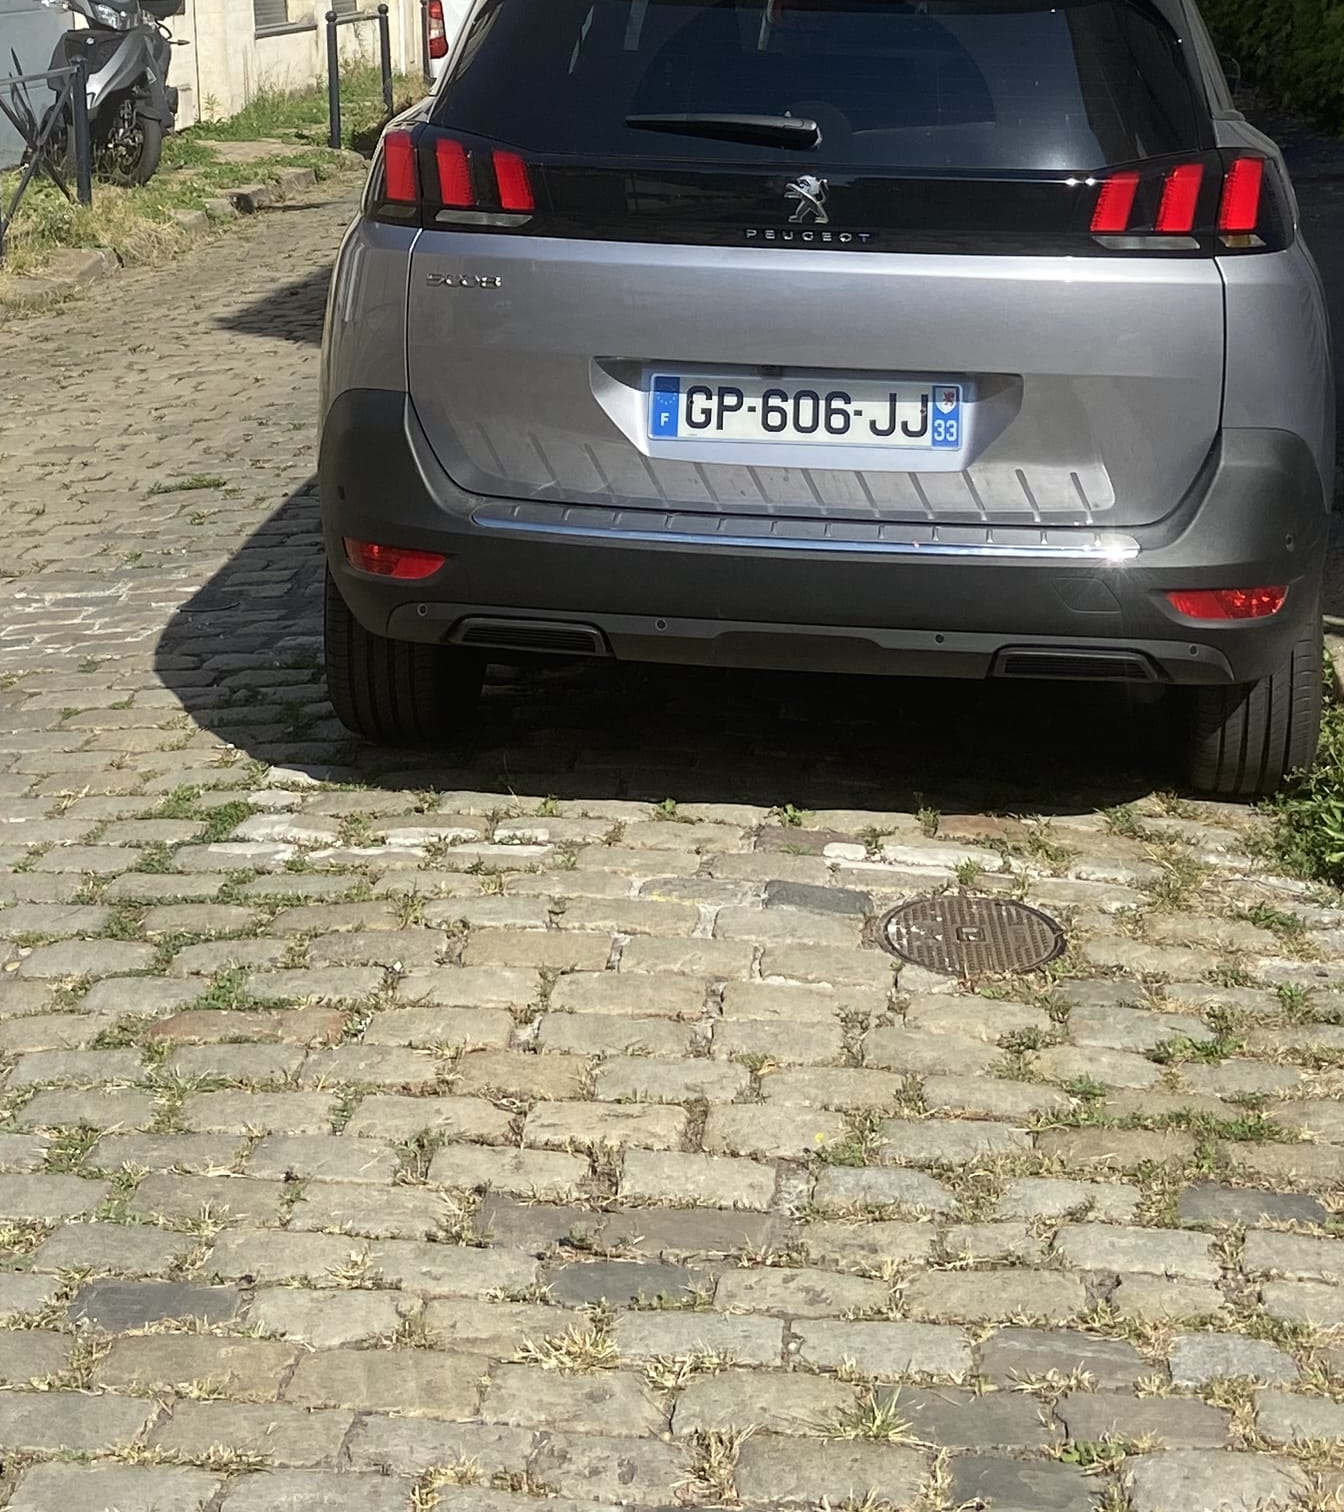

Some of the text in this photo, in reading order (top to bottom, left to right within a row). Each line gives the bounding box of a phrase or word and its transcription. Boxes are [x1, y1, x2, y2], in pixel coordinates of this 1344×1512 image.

[745, 229, 871, 243] PEUGEOT
[660, 385, 957, 442] F GP-606-JJ 33
